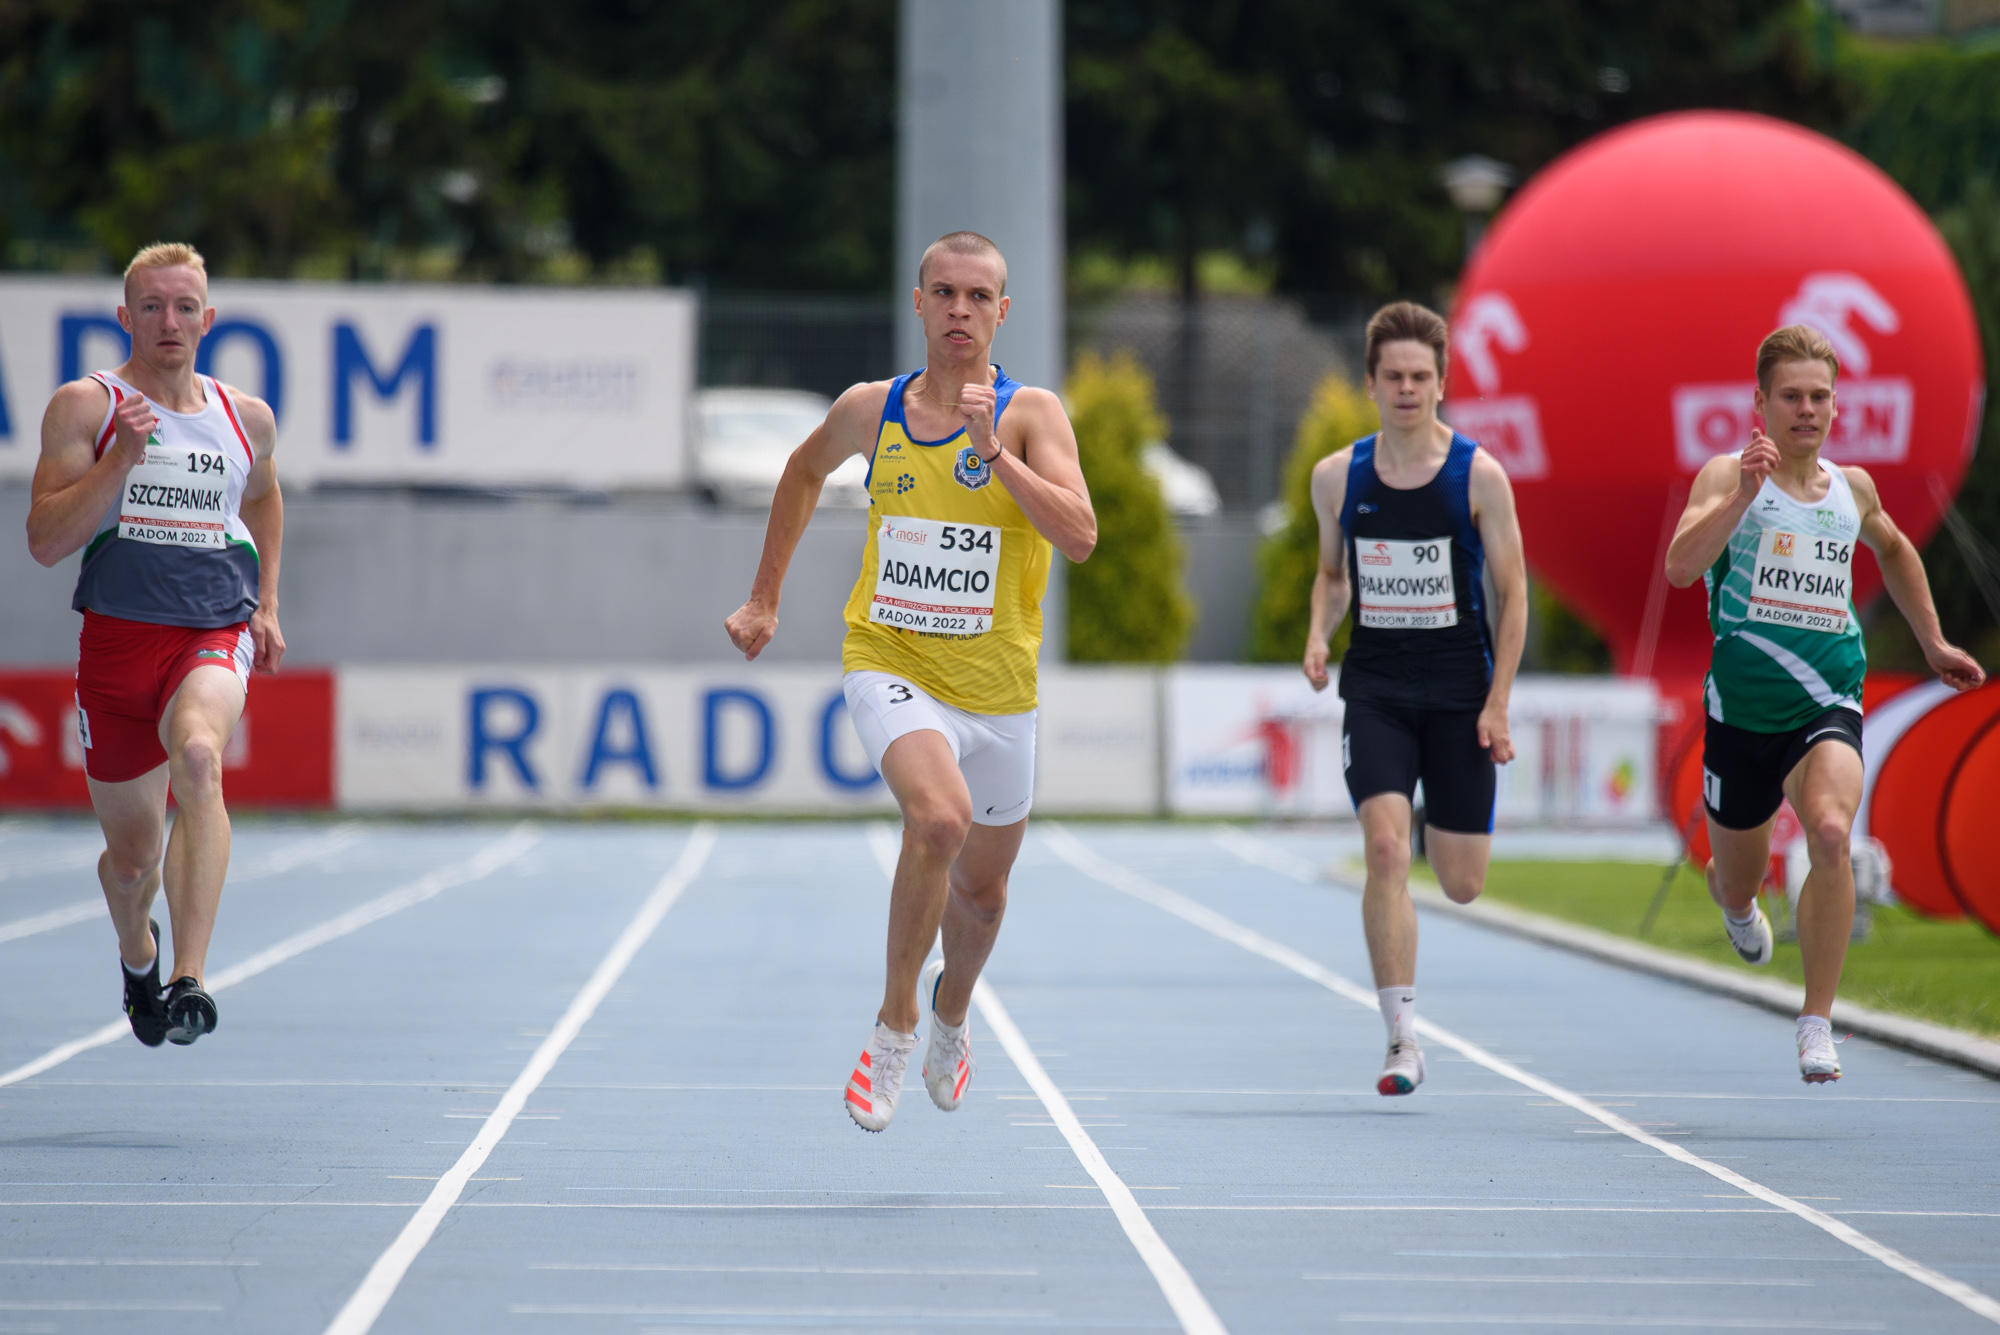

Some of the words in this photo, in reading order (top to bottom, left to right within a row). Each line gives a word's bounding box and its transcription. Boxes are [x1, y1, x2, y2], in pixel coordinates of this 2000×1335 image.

[187, 452, 225, 475] 194
[128, 484, 223, 511] SZCZEPANIAK
[143, 519, 190, 528] MISTRZOSTWA
[128, 527, 178, 541] RADOM
[181, 532, 207, 543] 2022
[896, 529, 928, 543] mosir
[939, 526, 993, 554] 534
[1413, 545, 1440, 565] 90
[1814, 540, 1849, 564] 156
[882, 559, 990, 594] ADAMCIO
[1360, 575, 1450, 596] PAŁKOWSKI
[1758, 566, 1846, 600] KRYSIAK
[875, 595, 893, 605] PZLA
[894, 600, 944, 613] MISTRZOSTWA
[945, 606, 973, 615] POLSKI
[878, 608, 927, 627] RADOM
[931, 617, 967, 630] 2022
[1364, 614, 1408, 625] RADOM
[1411, 615, 1438, 625] 2022
[1756, 608, 1803, 624] RADOM
[1806, 615, 1832, 628] 2022
[888, 684, 913, 704] 3
